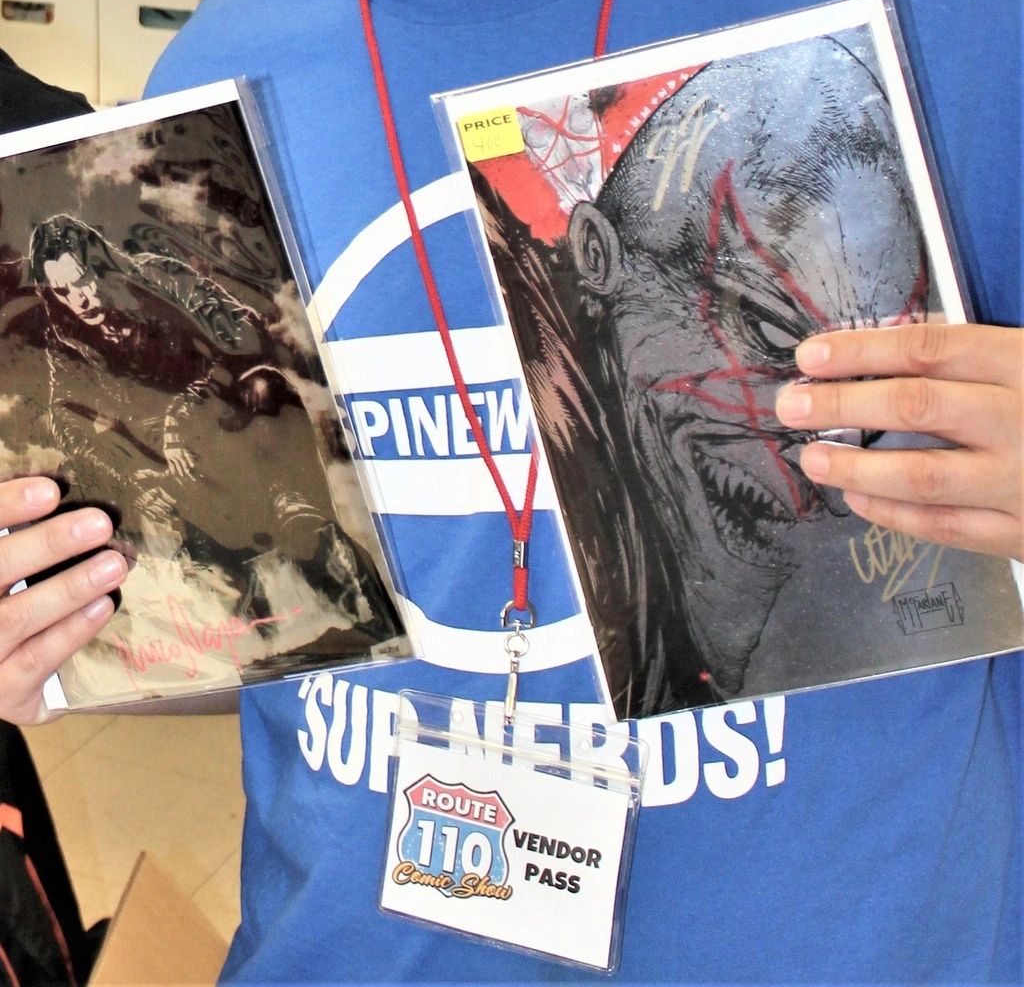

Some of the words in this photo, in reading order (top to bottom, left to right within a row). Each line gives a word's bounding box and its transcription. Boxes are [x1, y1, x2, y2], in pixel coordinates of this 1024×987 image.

[464, 114, 512, 132] PRICE
[336, 387, 532, 457] PINEW
[421, 787, 498, 824] ROUTE
[418, 819, 493, 875] 110
[513, 829, 602, 869] VENDOR
[392, 861, 456, 890] Comic
[451, 872, 513, 900] Show
[524, 863, 582, 894] PASS
